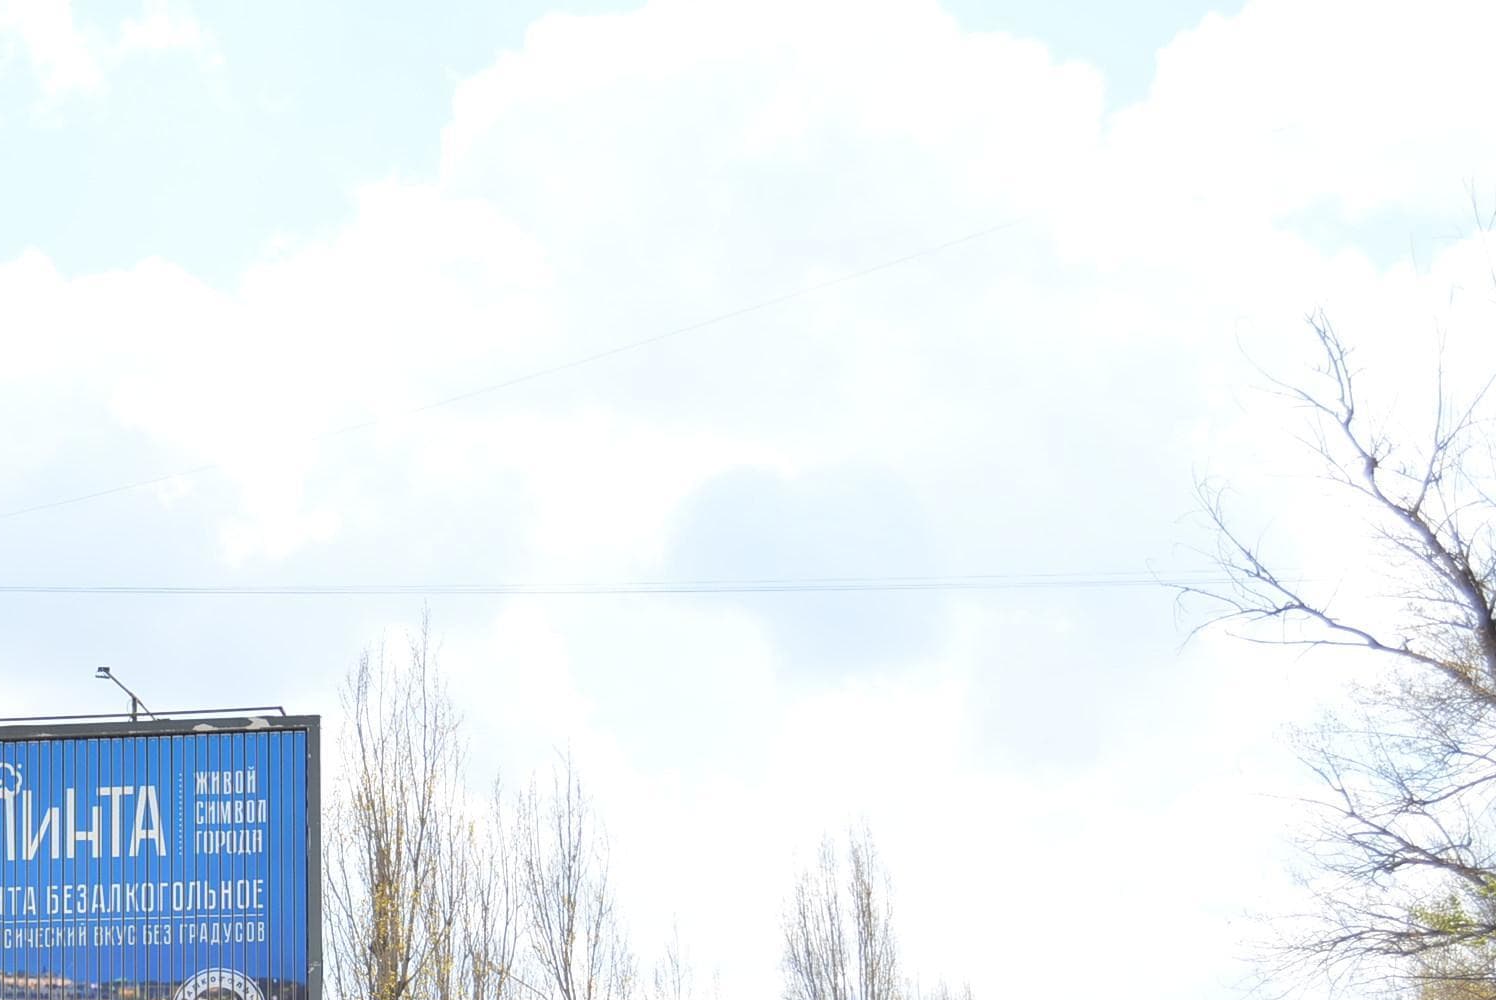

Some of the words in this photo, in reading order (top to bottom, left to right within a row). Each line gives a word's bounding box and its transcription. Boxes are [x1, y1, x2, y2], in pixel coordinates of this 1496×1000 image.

[194, 766, 256, 795] ЖИВОЙ
[195, 799, 267, 825] СИМВОЛ
[46, 879, 264, 915] БЕЗАЛКОГОЛЬНОЕ
[93, 923, 136, 947] ВКУС
[142, 923, 172, 945] БЕЗ
[179, 920, 265, 945] ГРАДУСОВ
